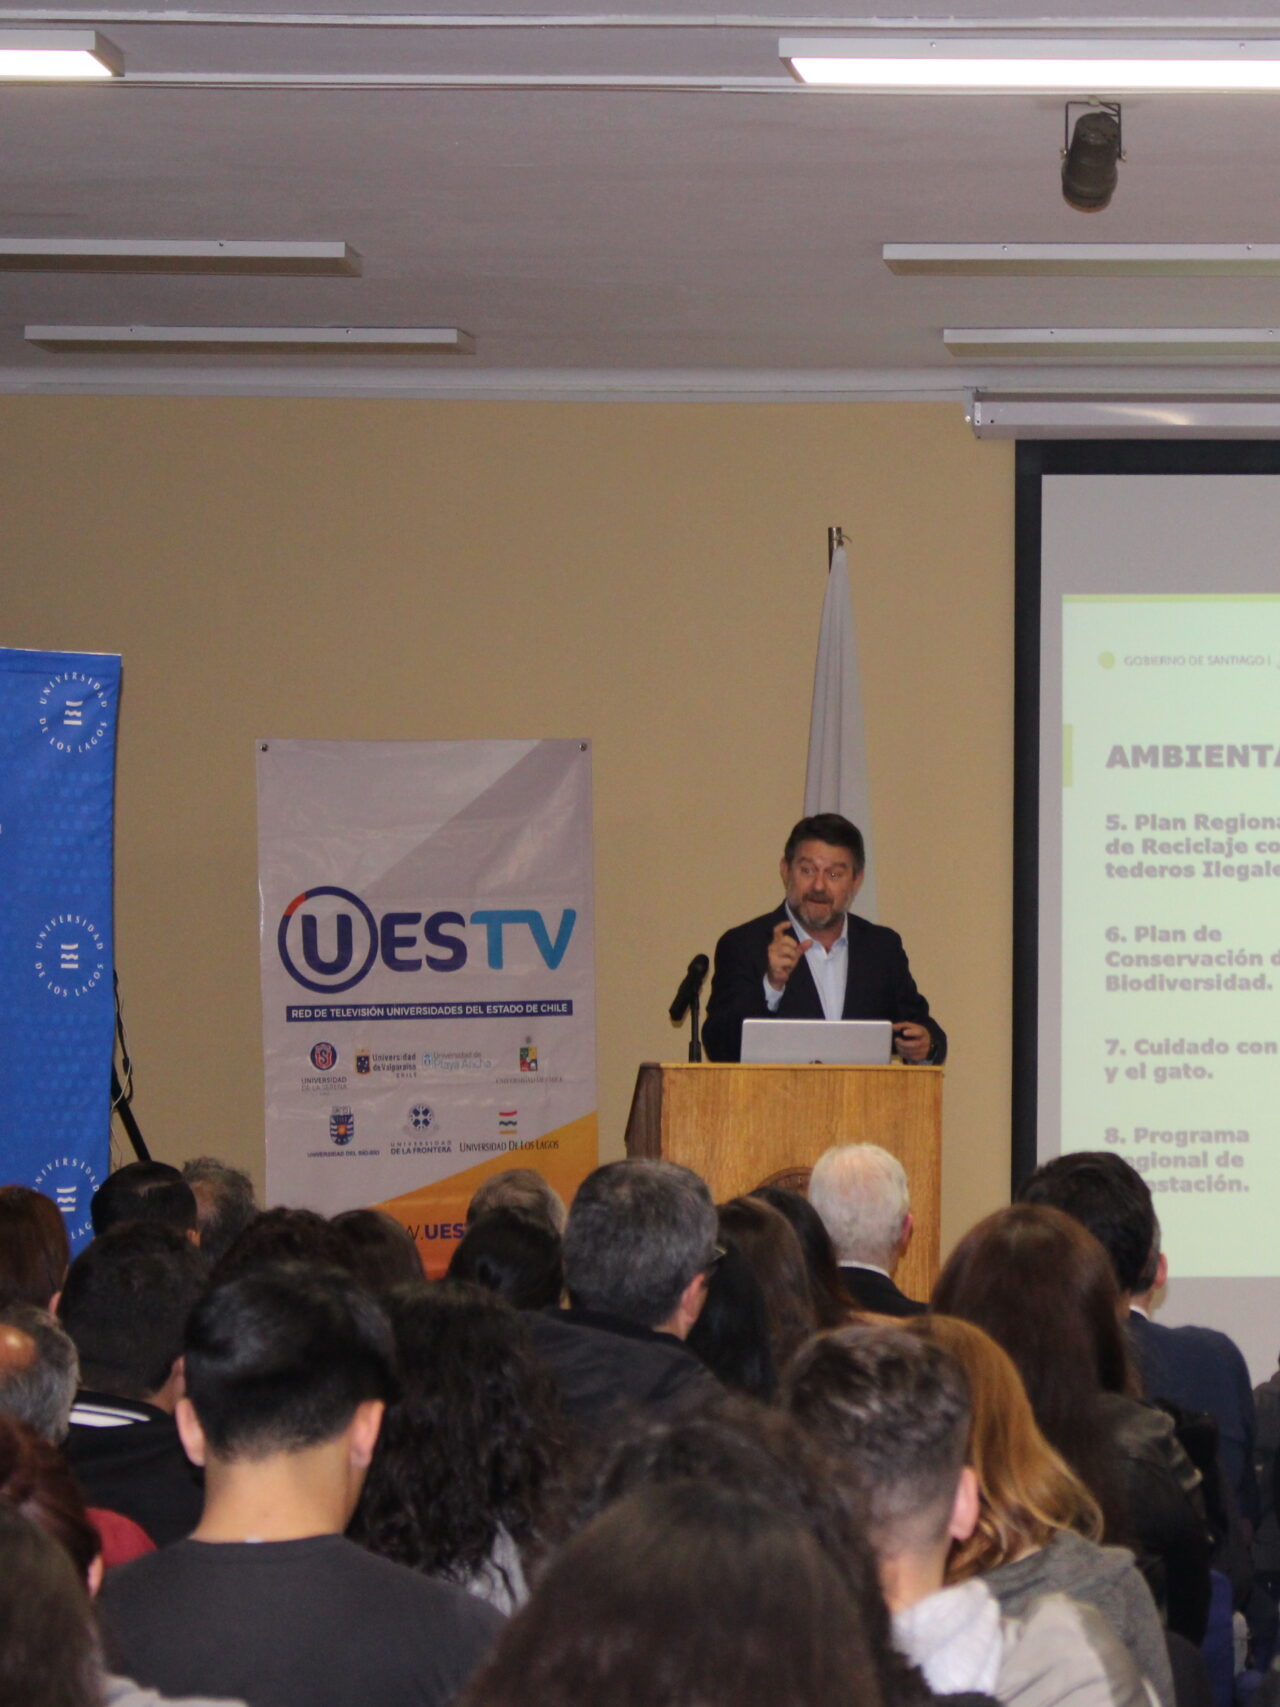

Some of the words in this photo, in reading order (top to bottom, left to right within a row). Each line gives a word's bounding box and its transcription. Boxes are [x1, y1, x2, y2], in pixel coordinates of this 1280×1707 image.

[1123, 655, 1185, 667] GOBIERNO
[1189, 655, 1204, 666] DE
[1207, 655, 1265, 667] SANTIAGO
[1105, 814, 1127, 831] 5.
[1135, 813, 1187, 831] Plan
[1105, 838, 1135, 855] de
[1142, 837, 1248, 858] Reciclaje
[1105, 862, 1196, 878] tederos
[1105, 926, 1127, 943] 6.
[1134, 925, 1187, 942] Plan
[1193, 925, 1222, 942] de
[1105, 948, 1263, 967] Conservación
[1105, 974, 1273, 992] Biodiversidad.
[292, 1009, 312, 1018] RED
[314, 1008, 327, 1018] DE
[330, 1006, 384, 1017] TELEVISIÓN
[386, 1005, 463, 1016] UNIVERSIDADES
[465, 1005, 484, 1015] DEL
[486, 1004, 524, 1014] ESTADO
[526, 1004, 539, 1013] DE
[540, 1003, 568, 1013] CHILE
[1104, 1039, 1126, 1055] 7.
[1134, 1038, 1230, 1055] Cuidado
[1236, 1041, 1278, 1055] con
[1104, 1066, 1119, 1084] y
[1125, 1063, 1147, 1080] el
[1153, 1063, 1214, 1084] gato.
[1104, 1128, 1127, 1144] 8.
[1133, 1127, 1250, 1148] Programa
[1123, 1151, 1208, 1173] egional
[1215, 1151, 1244, 1168] de
